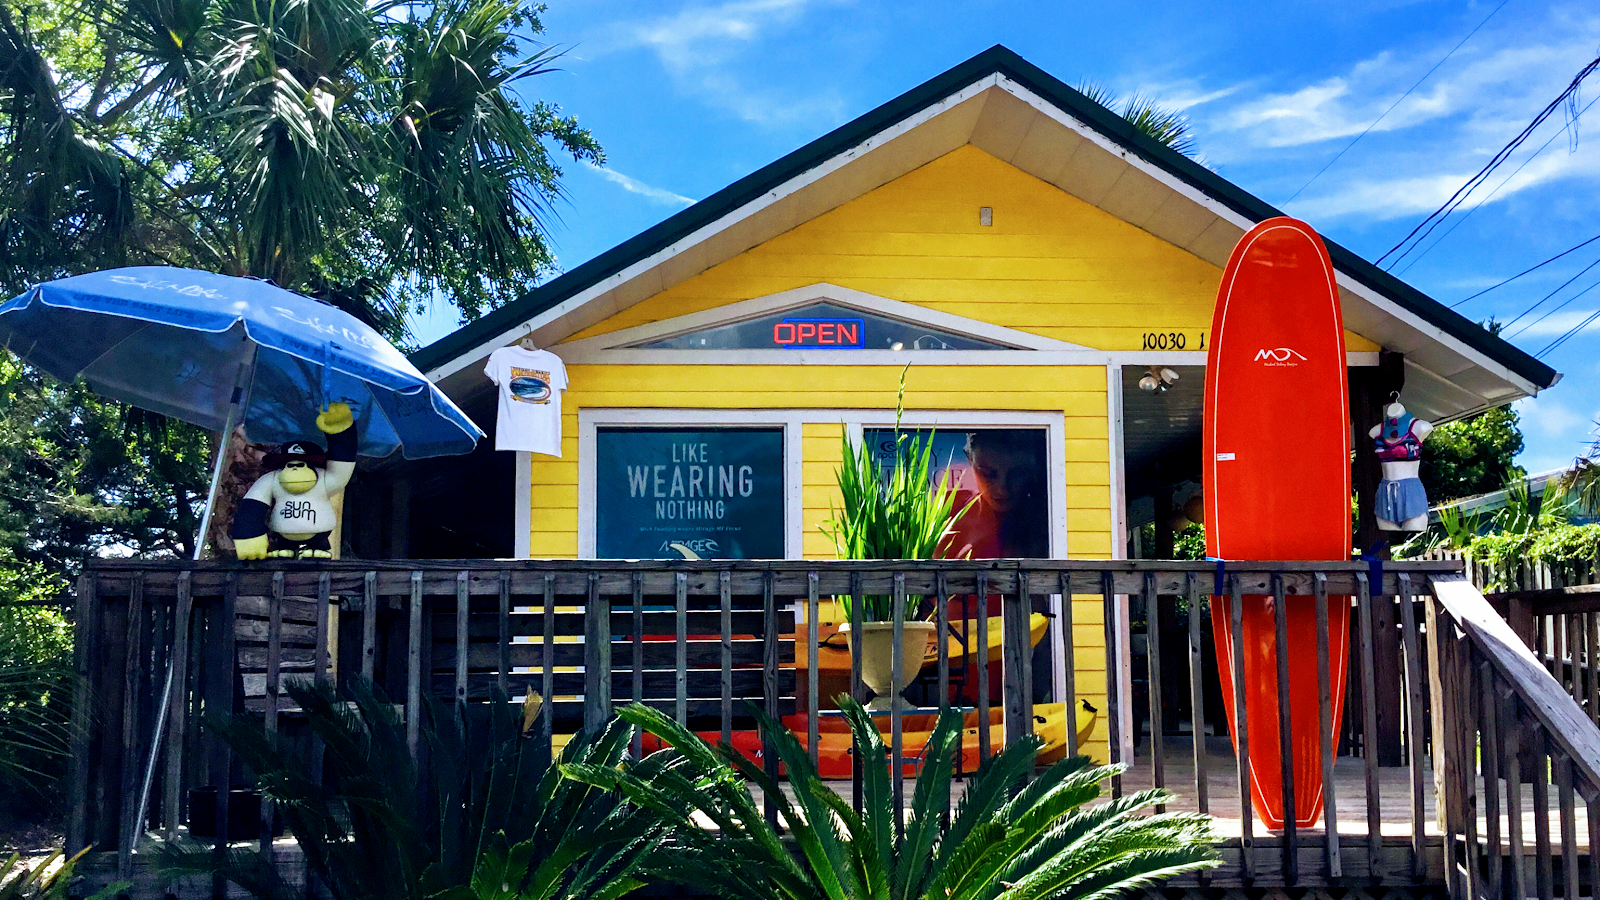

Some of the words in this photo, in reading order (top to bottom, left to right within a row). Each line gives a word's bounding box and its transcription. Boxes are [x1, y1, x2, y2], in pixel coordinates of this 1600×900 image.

[132, 301, 163, 312] SALT
[166, 307, 195, 320] LIFE
[773, 322, 857, 344] OPEN
[1142, 332, 1186, 350] 10030
[672, 443, 708, 463] LIKE
[627, 465, 753, 498] WEARING
[656, 500, 725, 520] NOTHING
